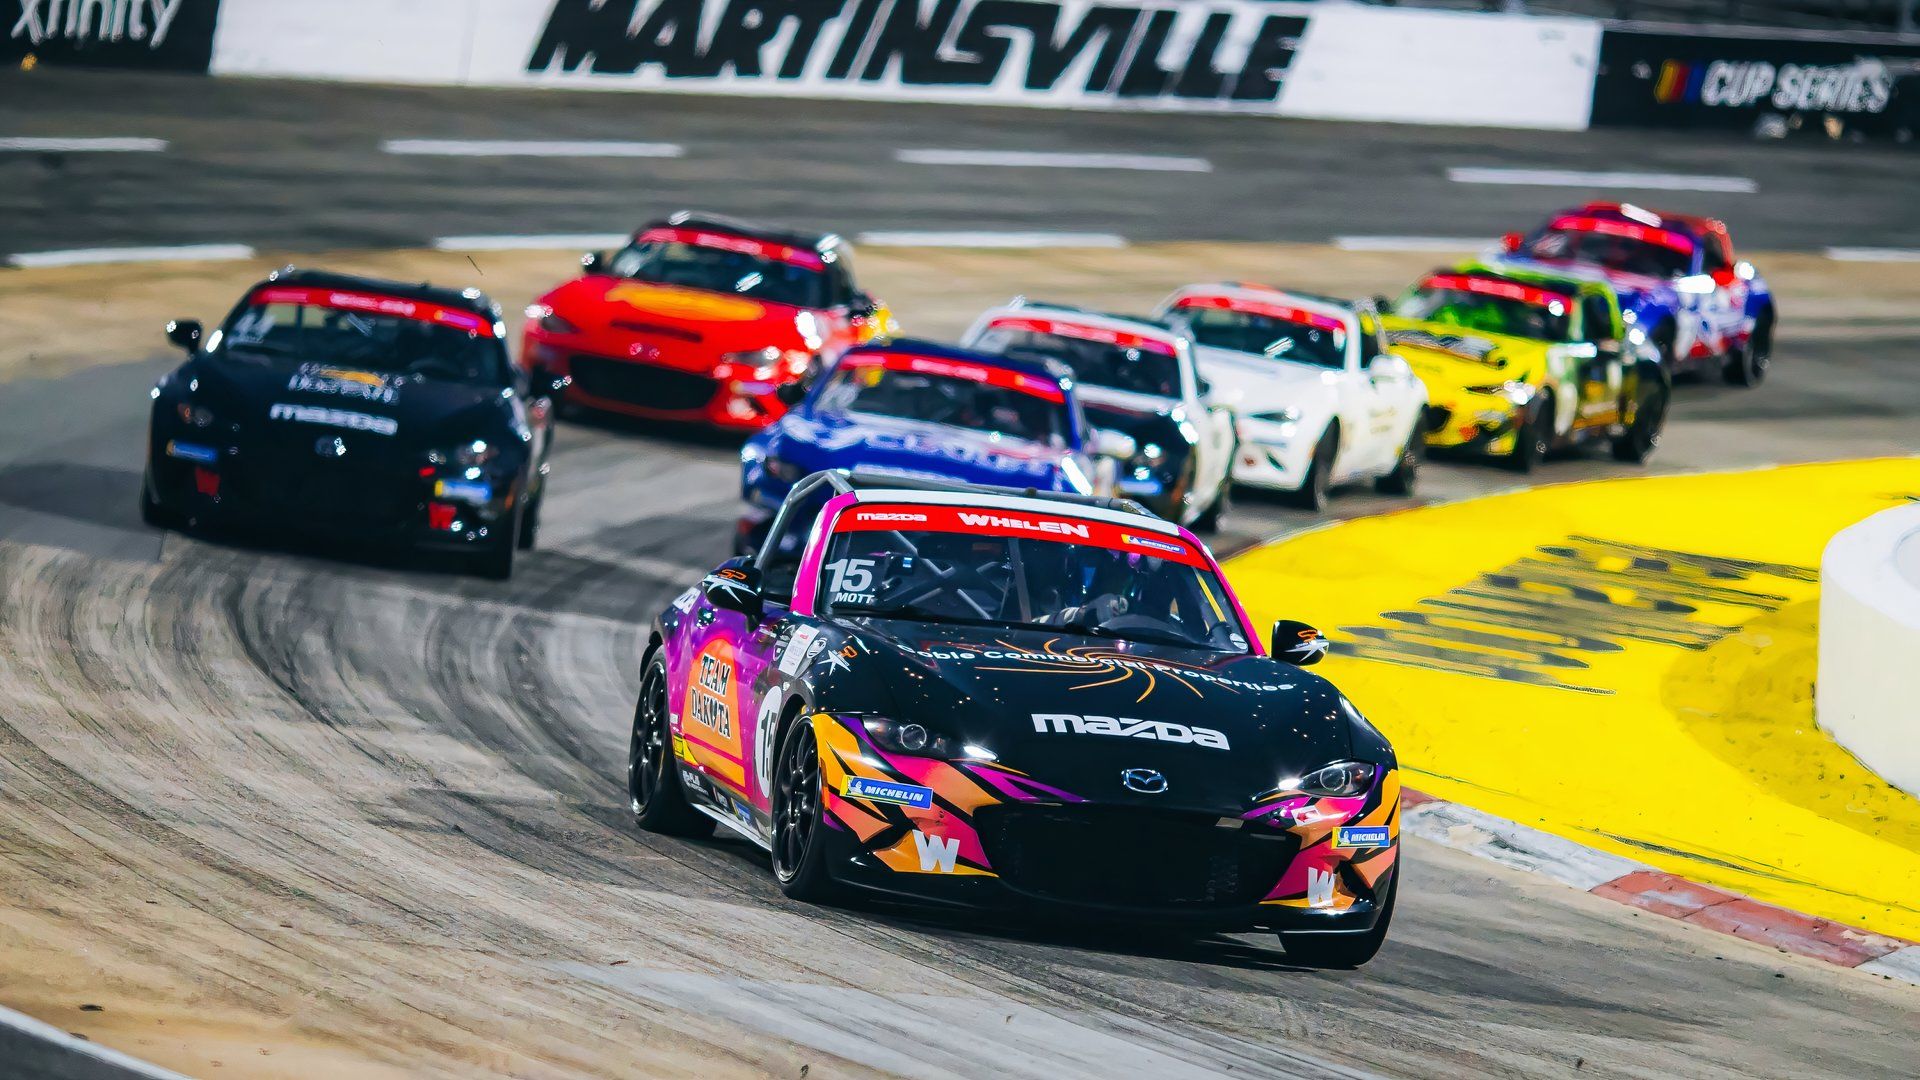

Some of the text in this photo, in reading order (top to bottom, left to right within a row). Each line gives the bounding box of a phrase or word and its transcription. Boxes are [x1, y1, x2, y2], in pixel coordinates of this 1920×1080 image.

[526, 0, 1309, 101] MARTINSVILLE
[1701, 59, 1777, 107] CUP
[956, 512, 1090, 539] WHELEN
[824, 558, 876, 593] 15
[834, 592, 876, 604] MOTT
[699, 652, 732, 698] TEAM
[983, 650, 1146, 669] Commercial
[1151, 663, 1294, 692] Properties
[1030, 712, 1231, 751] mazda
[864, 784, 925, 802] MICHELIN
[911, 828, 961, 873] W
[1350, 832, 1386, 843] MICHELIN
[1307, 866, 1337, 908] W
